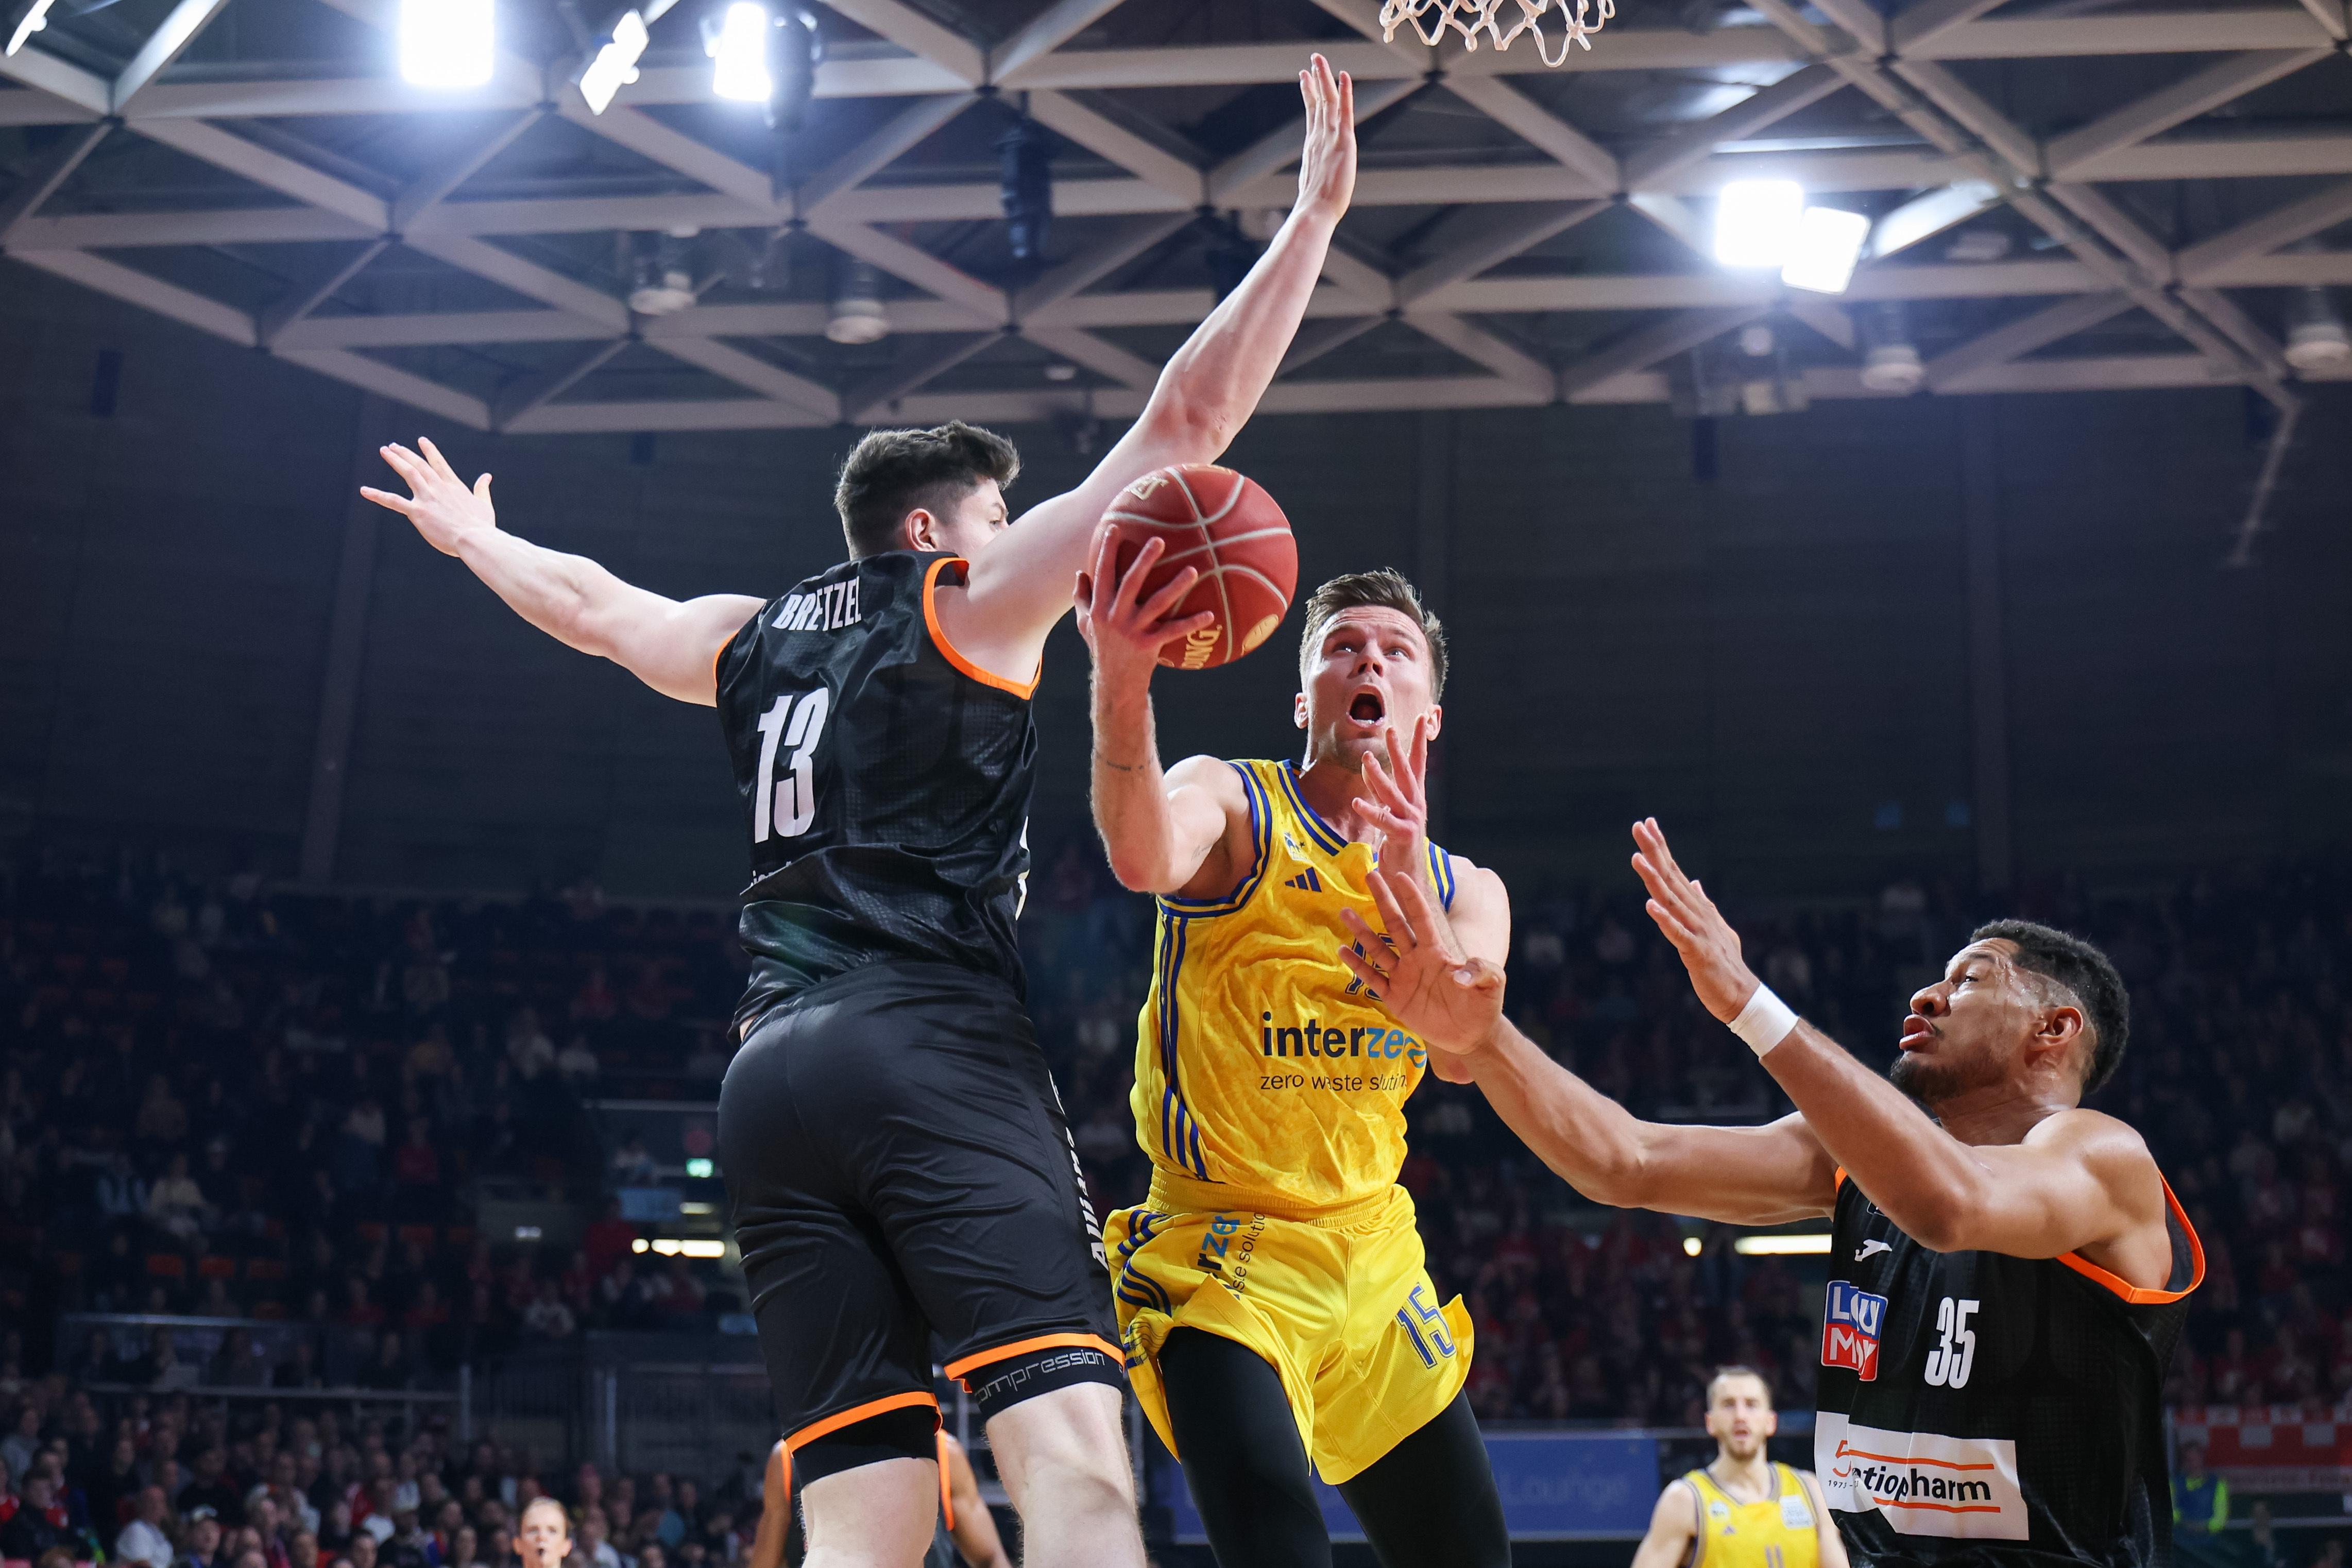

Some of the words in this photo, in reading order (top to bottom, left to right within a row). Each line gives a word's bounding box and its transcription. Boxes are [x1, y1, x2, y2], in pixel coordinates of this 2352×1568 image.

[771, 576, 861, 631] BRETZEL
[755, 687, 829, 843] 13
[1260, 1075, 1304, 1090] zero
[1395, 1281, 1457, 1369] 15
[1924, 1297, 1980, 1389] 35
[975, 1350, 1105, 1404] ompression
